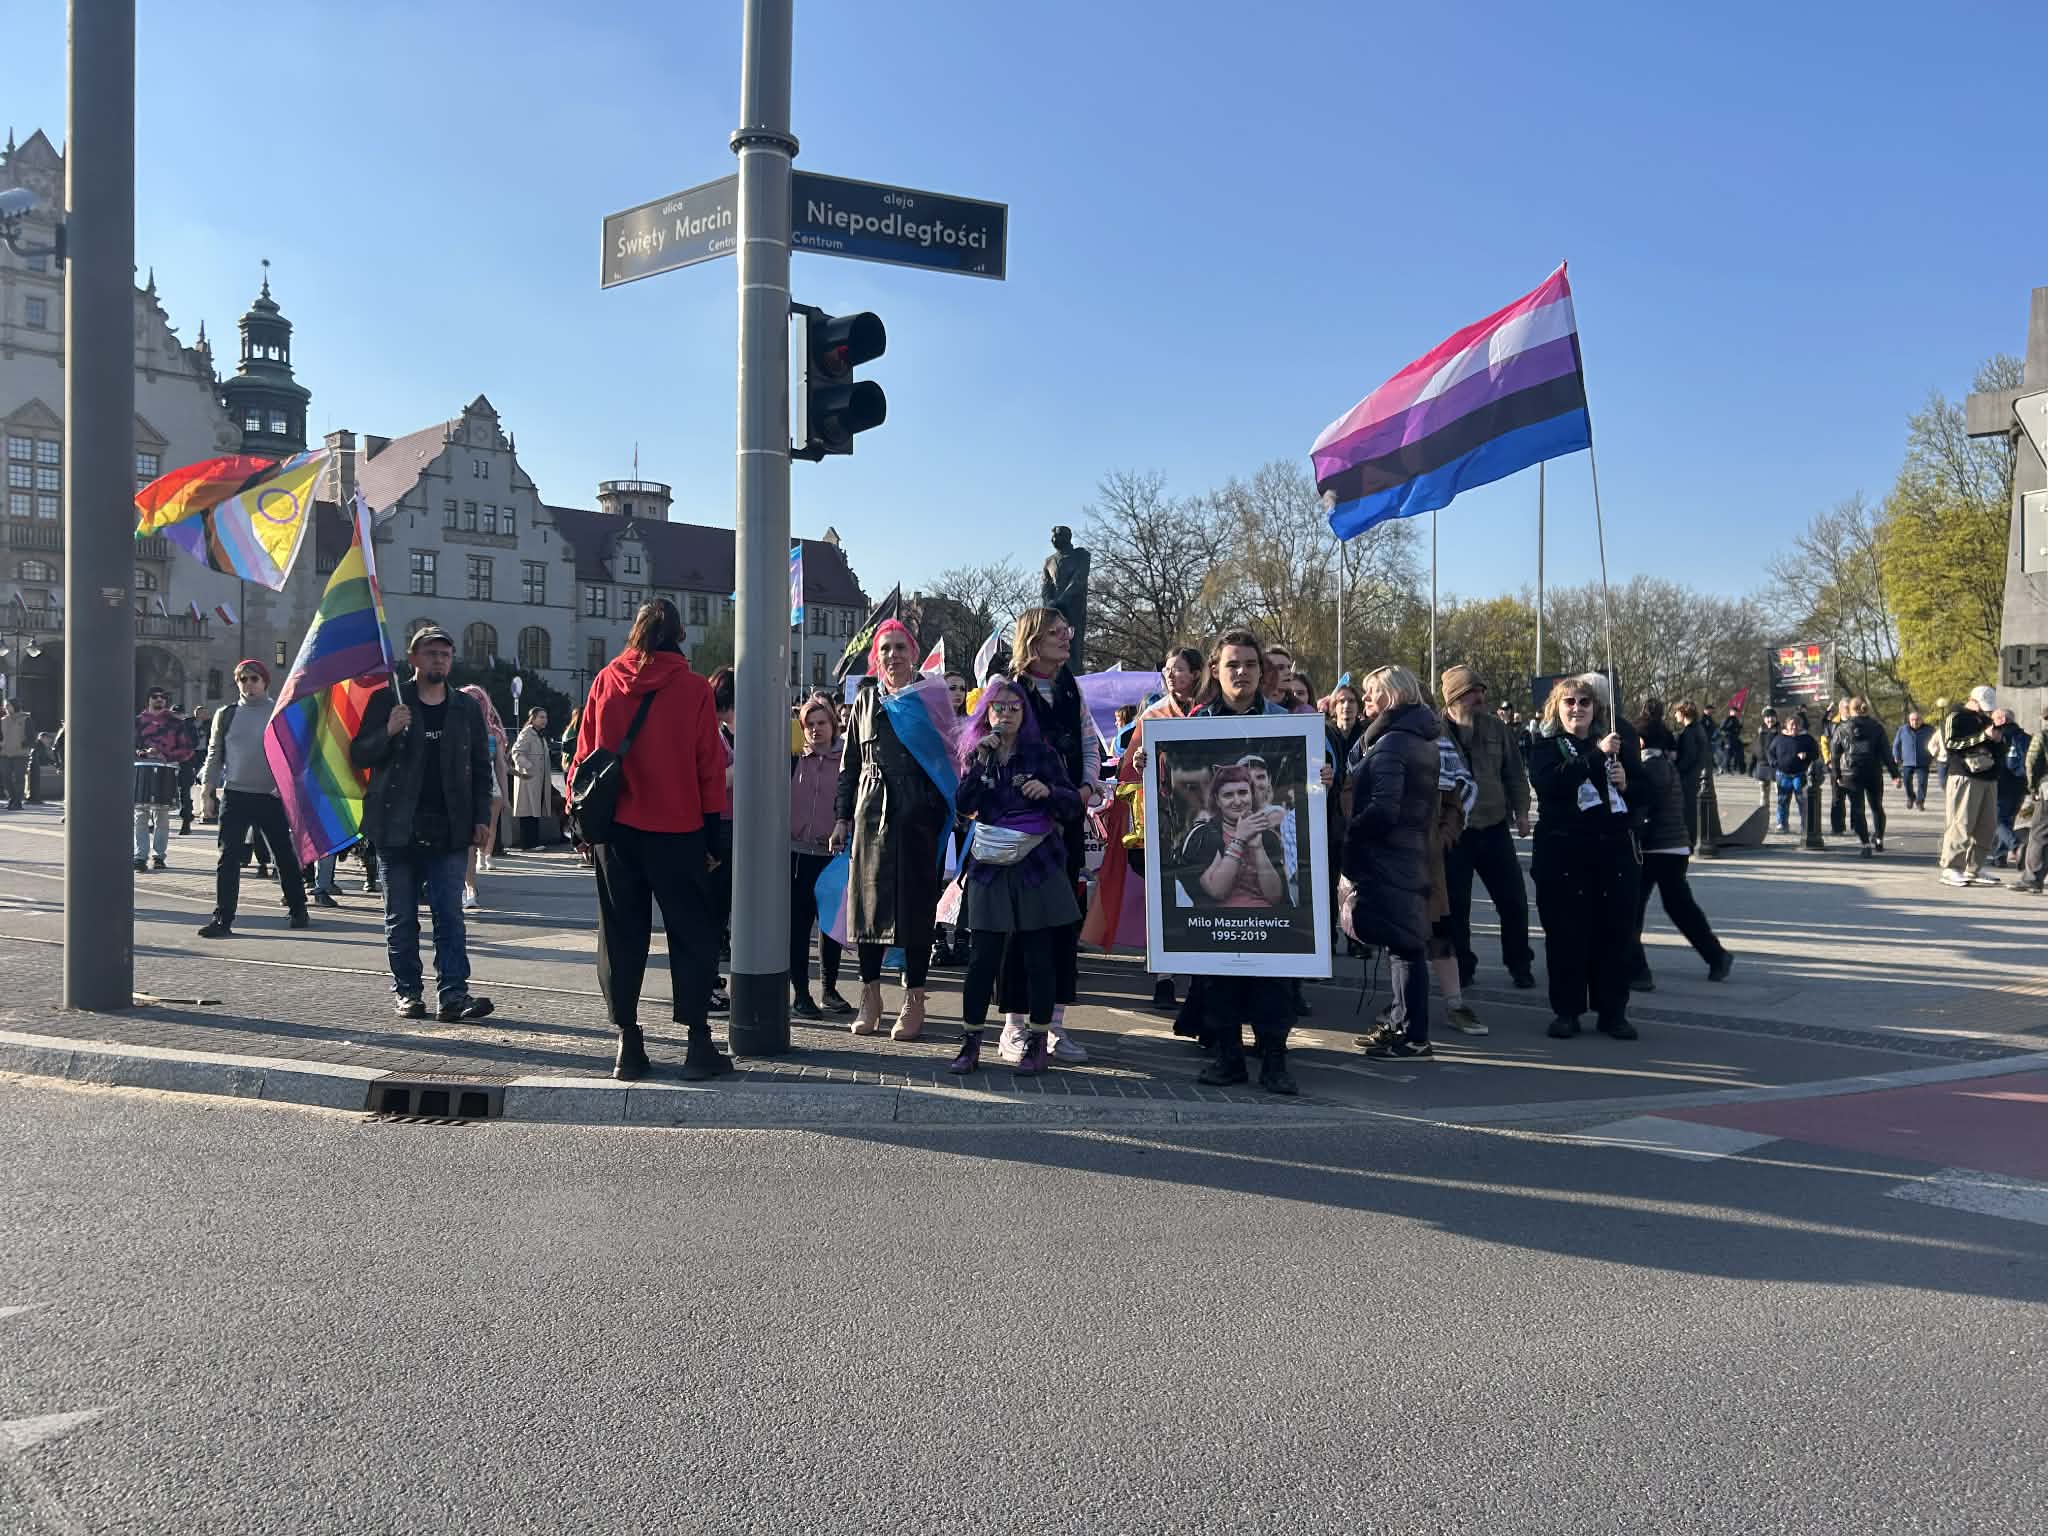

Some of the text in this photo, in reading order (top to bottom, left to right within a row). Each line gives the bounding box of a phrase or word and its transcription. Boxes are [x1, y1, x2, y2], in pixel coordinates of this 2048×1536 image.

[662, 201, 684, 216] ulica
[883, 192, 914, 209] aleja
[616, 206, 732, 259] Święty Marcin
[807, 200, 987, 249] Niepodległości
[791, 231, 843, 249] Centrum
[1188, 917, 1290, 928] Milo Mazurkiewicz
[1211, 930, 1267, 941] 1995-2019
